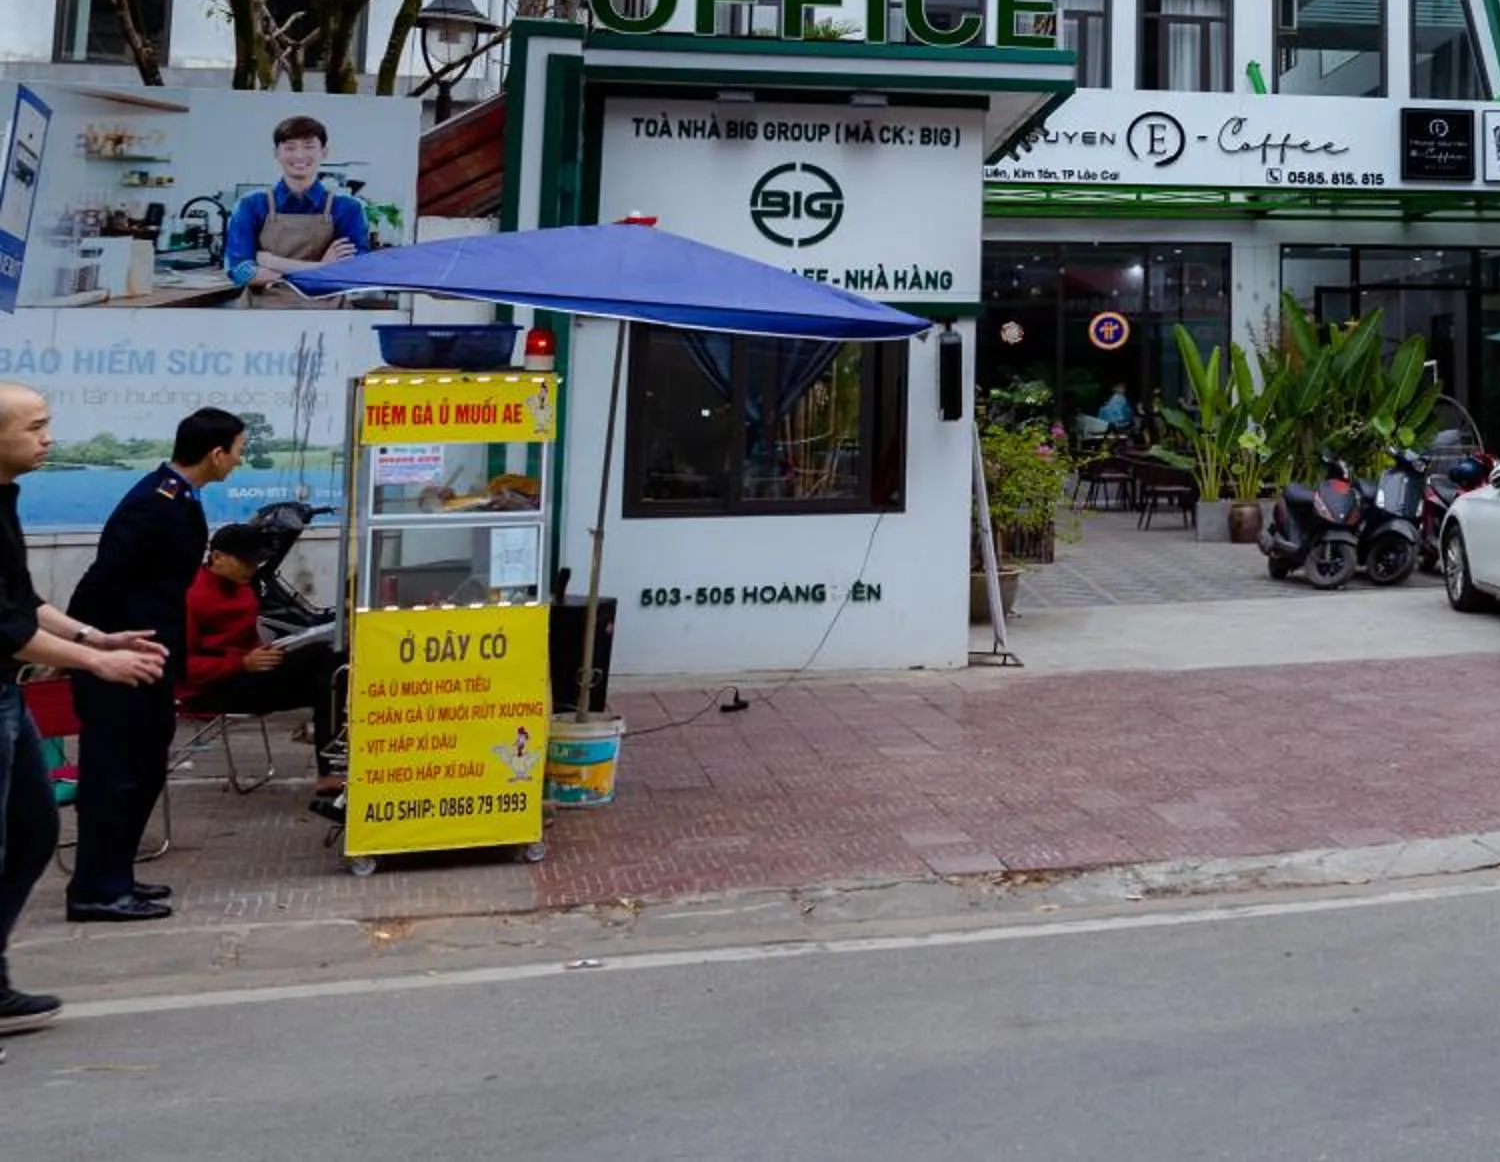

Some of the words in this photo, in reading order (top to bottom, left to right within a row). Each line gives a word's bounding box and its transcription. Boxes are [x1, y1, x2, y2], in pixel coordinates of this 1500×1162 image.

[632, 116, 673, 140] TOÀ
[677, 116, 721, 141] NHÀ
[726, 122, 759, 142] BIG
[763, 123, 830, 144] GROUP
[1218, 116, 1350, 165] Coffee
[844, 263, 889, 291] NHÀ
[893, 263, 953, 291] HÀNG
[366, 401, 406, 431] TIỆM
[412, 400, 433, 425] GÀ
[455, 396, 497, 424] MUỐI
[502, 404, 523, 423] AE
[742, 581, 827, 605] HOÀNG
[399, 629, 415, 663] Ở
[424, 629, 470, 662] ĐÂY
[479, 626, 507, 660] CÓ
[387, 765, 412, 783] HEO
[365, 800, 394, 823] ALO
[396, 799, 435, 821] SHIP:
[439, 796, 474, 817] 0868
[476, 795, 493, 815] 79
[497, 792, 527, 813] 1993
